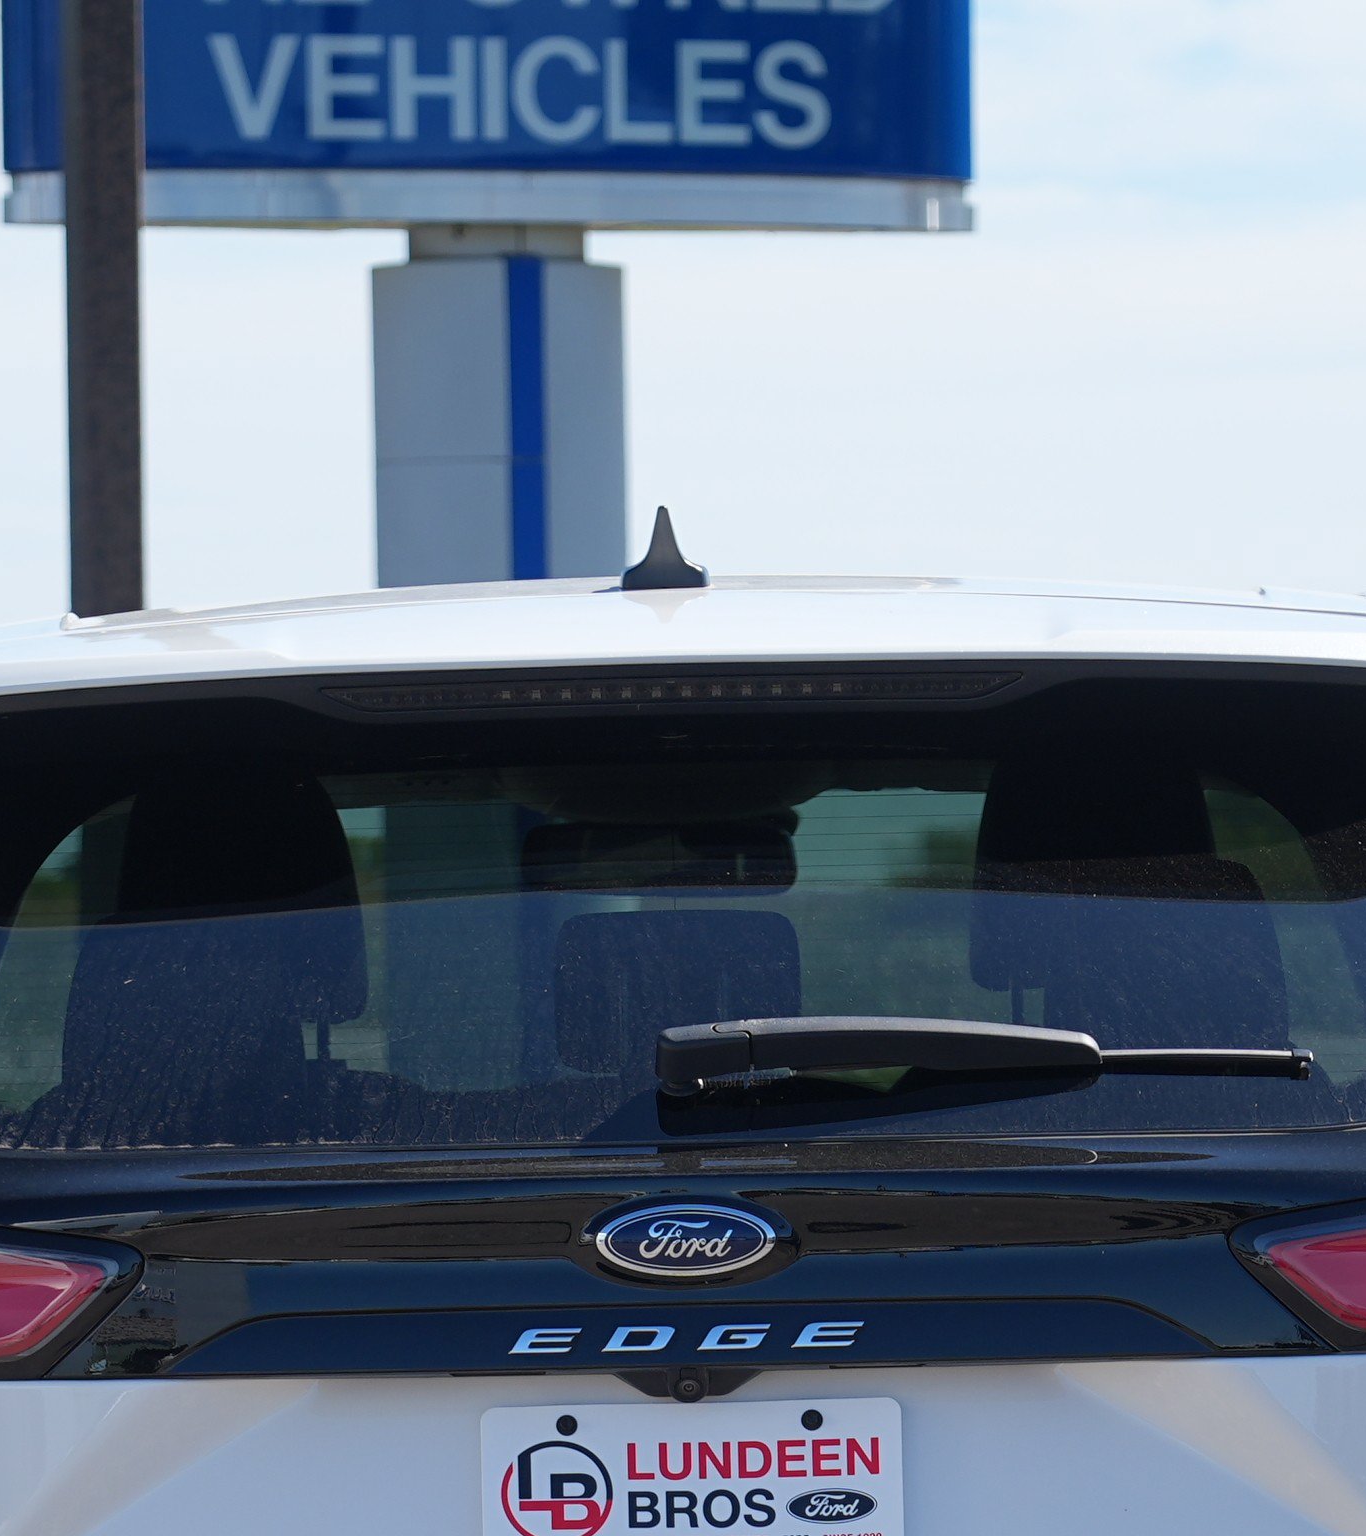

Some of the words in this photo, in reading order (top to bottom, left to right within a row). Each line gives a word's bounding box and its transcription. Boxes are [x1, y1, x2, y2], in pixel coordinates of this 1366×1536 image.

[205, 33, 833, 149] VEHICLES
[639, 1220, 732, 1260] Ford
[507, 1320, 866, 1355] EDGE
[626, 1437, 881, 1481] LUNDEEN
[627, 1488, 777, 1529] BROS
[804, 1494, 860, 1518] Ford
